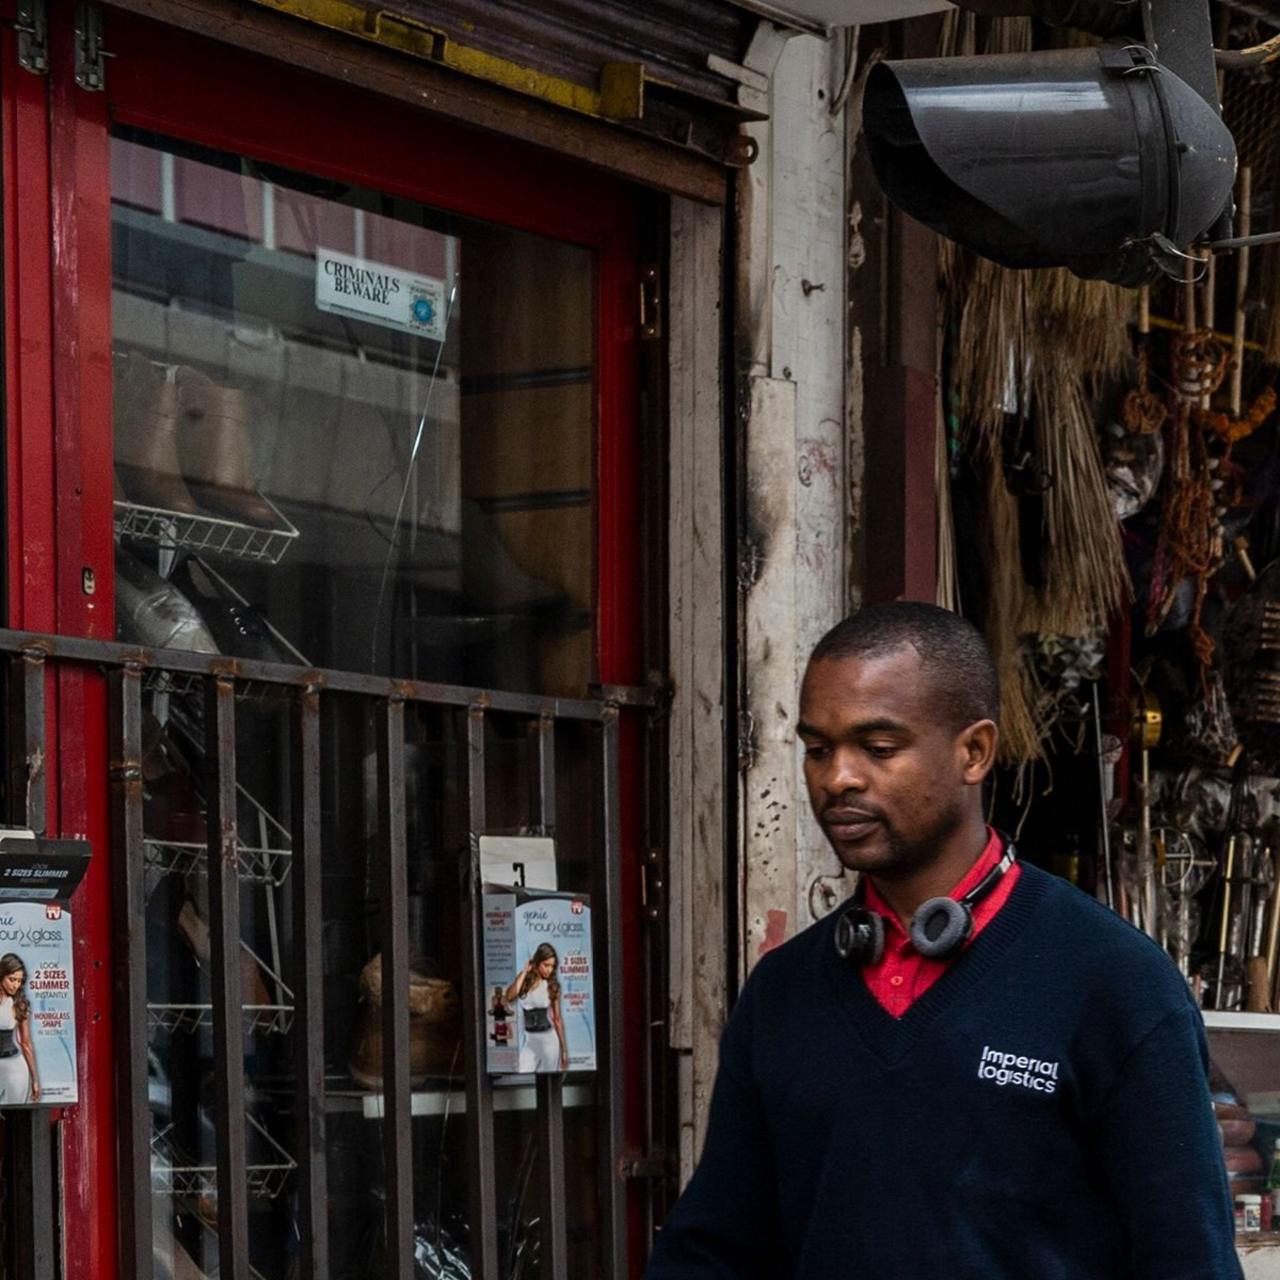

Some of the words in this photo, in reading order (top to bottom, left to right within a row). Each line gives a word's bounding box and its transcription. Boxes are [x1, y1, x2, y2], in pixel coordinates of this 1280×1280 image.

[324, 259, 400, 293] CRIMINALS
[334, 277, 390, 305] BEWARE
[29, 979, 70, 990] SLIMMER
[43, 971, 67, 979] SIZES
[978, 1061, 1056, 1093] logistics
[981, 1046, 1059, 1079] Imperial
